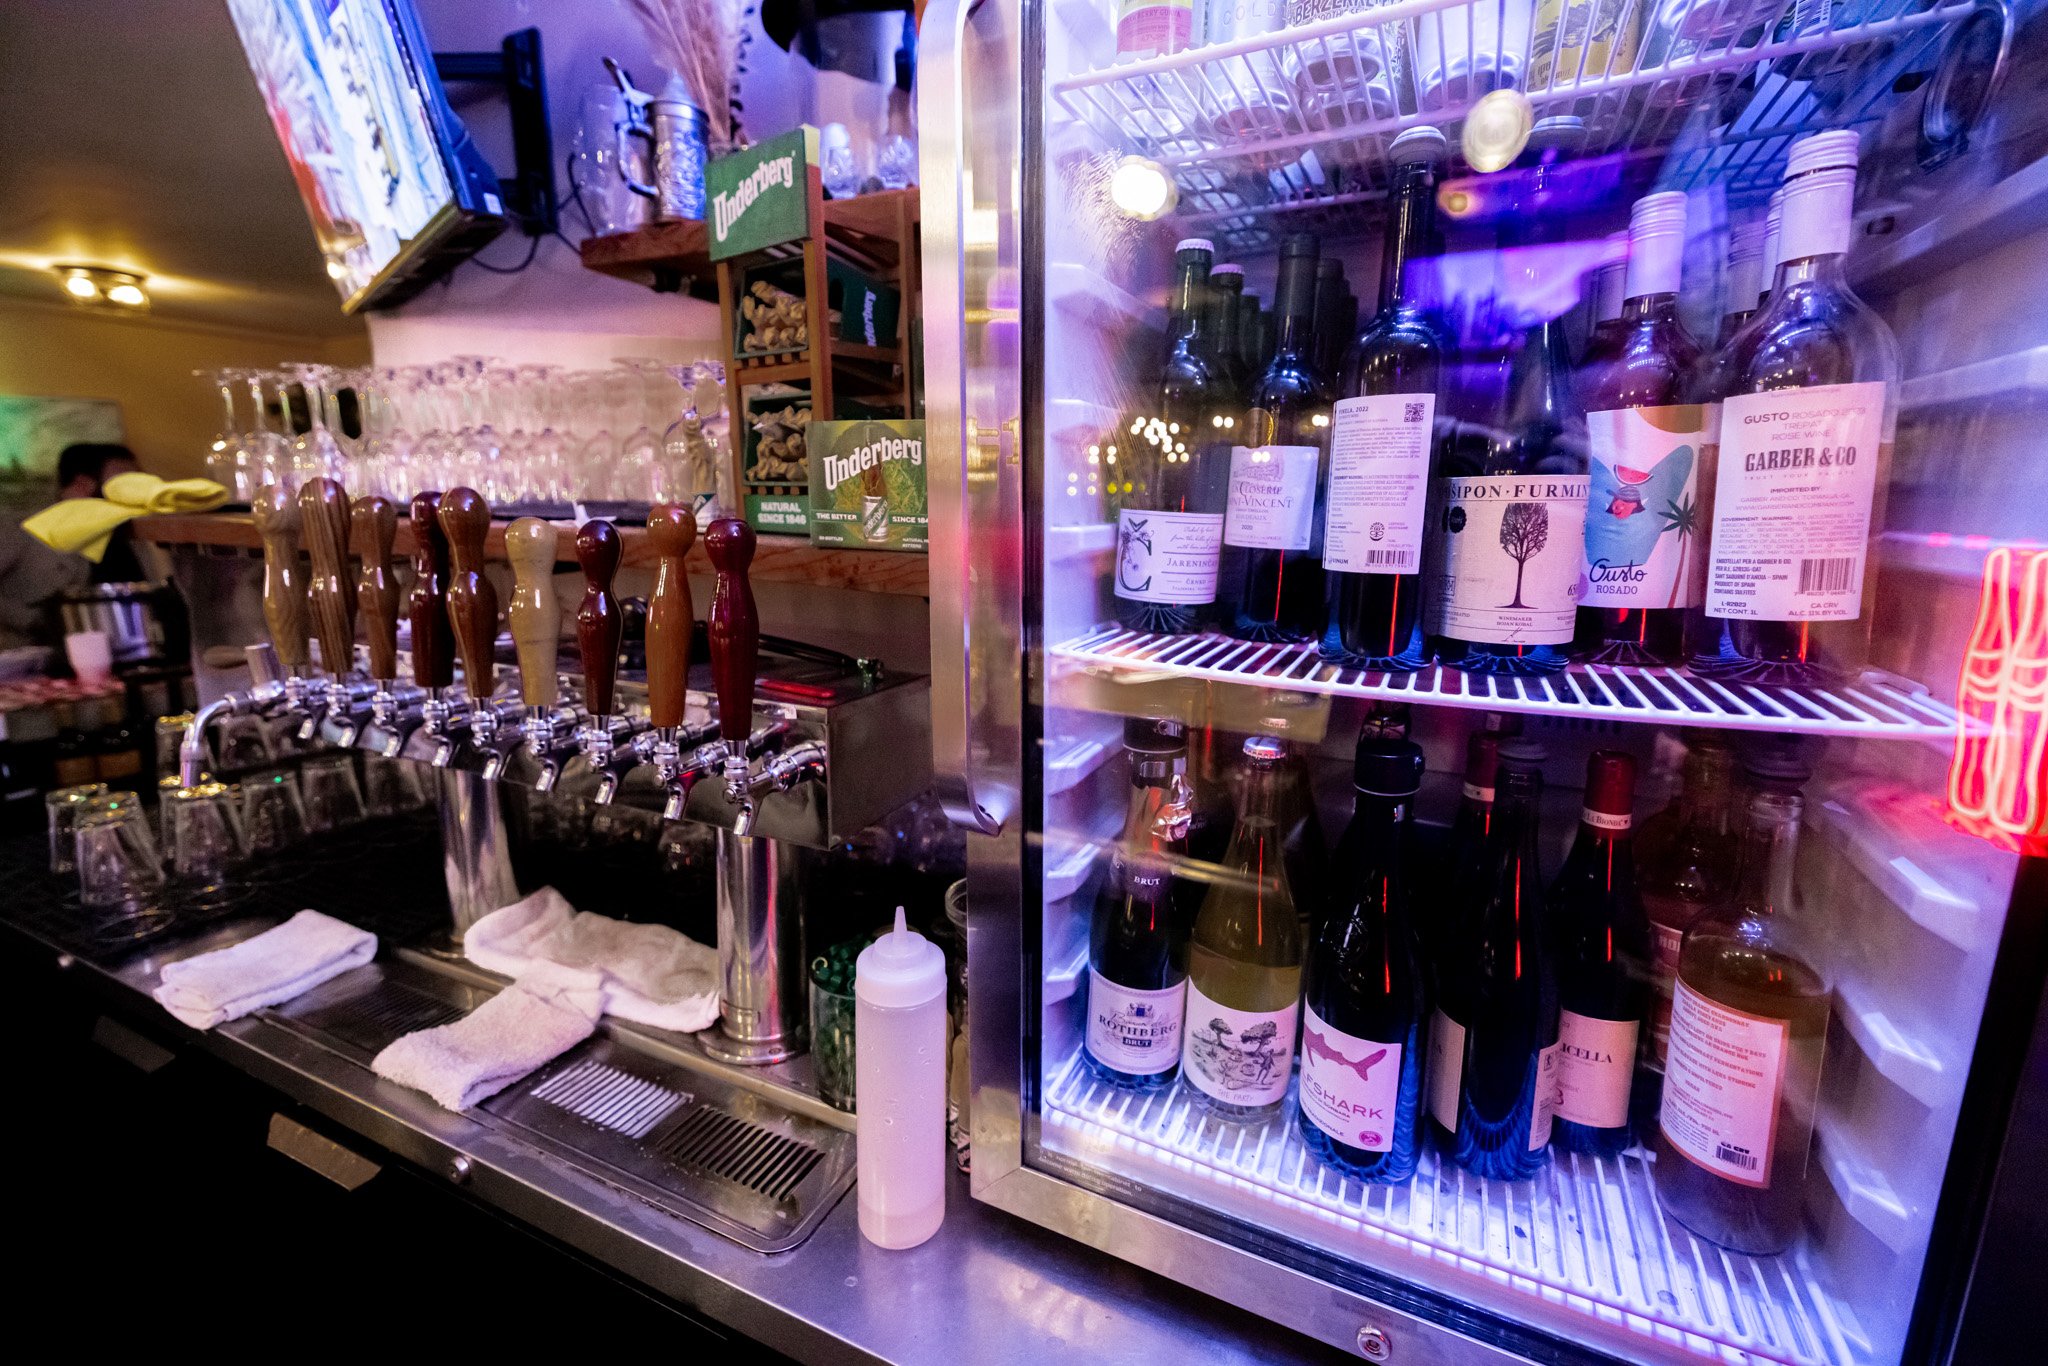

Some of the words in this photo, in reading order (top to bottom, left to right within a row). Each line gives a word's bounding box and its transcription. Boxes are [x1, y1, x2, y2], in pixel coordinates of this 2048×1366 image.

[712, 156, 793, 242] Underberg
[1743, 411, 1790, 425] GUSTO
[823, 437, 922, 491] Underberg
[1744, 447, 1816, 472] GARBER
[761, 502, 801, 513] NATURAL
[757, 513, 785, 524] SINCE
[816, 512, 830, 520] THE
[1589, 558, 1648, 583] Gusto
[1595, 585, 1638, 595] ROSADO
[1134, 876, 1160, 886] BRUT
[1099, 1014, 1177, 1036] ROTHBERG
[1125, 1038, 1151, 1047] BRUT
